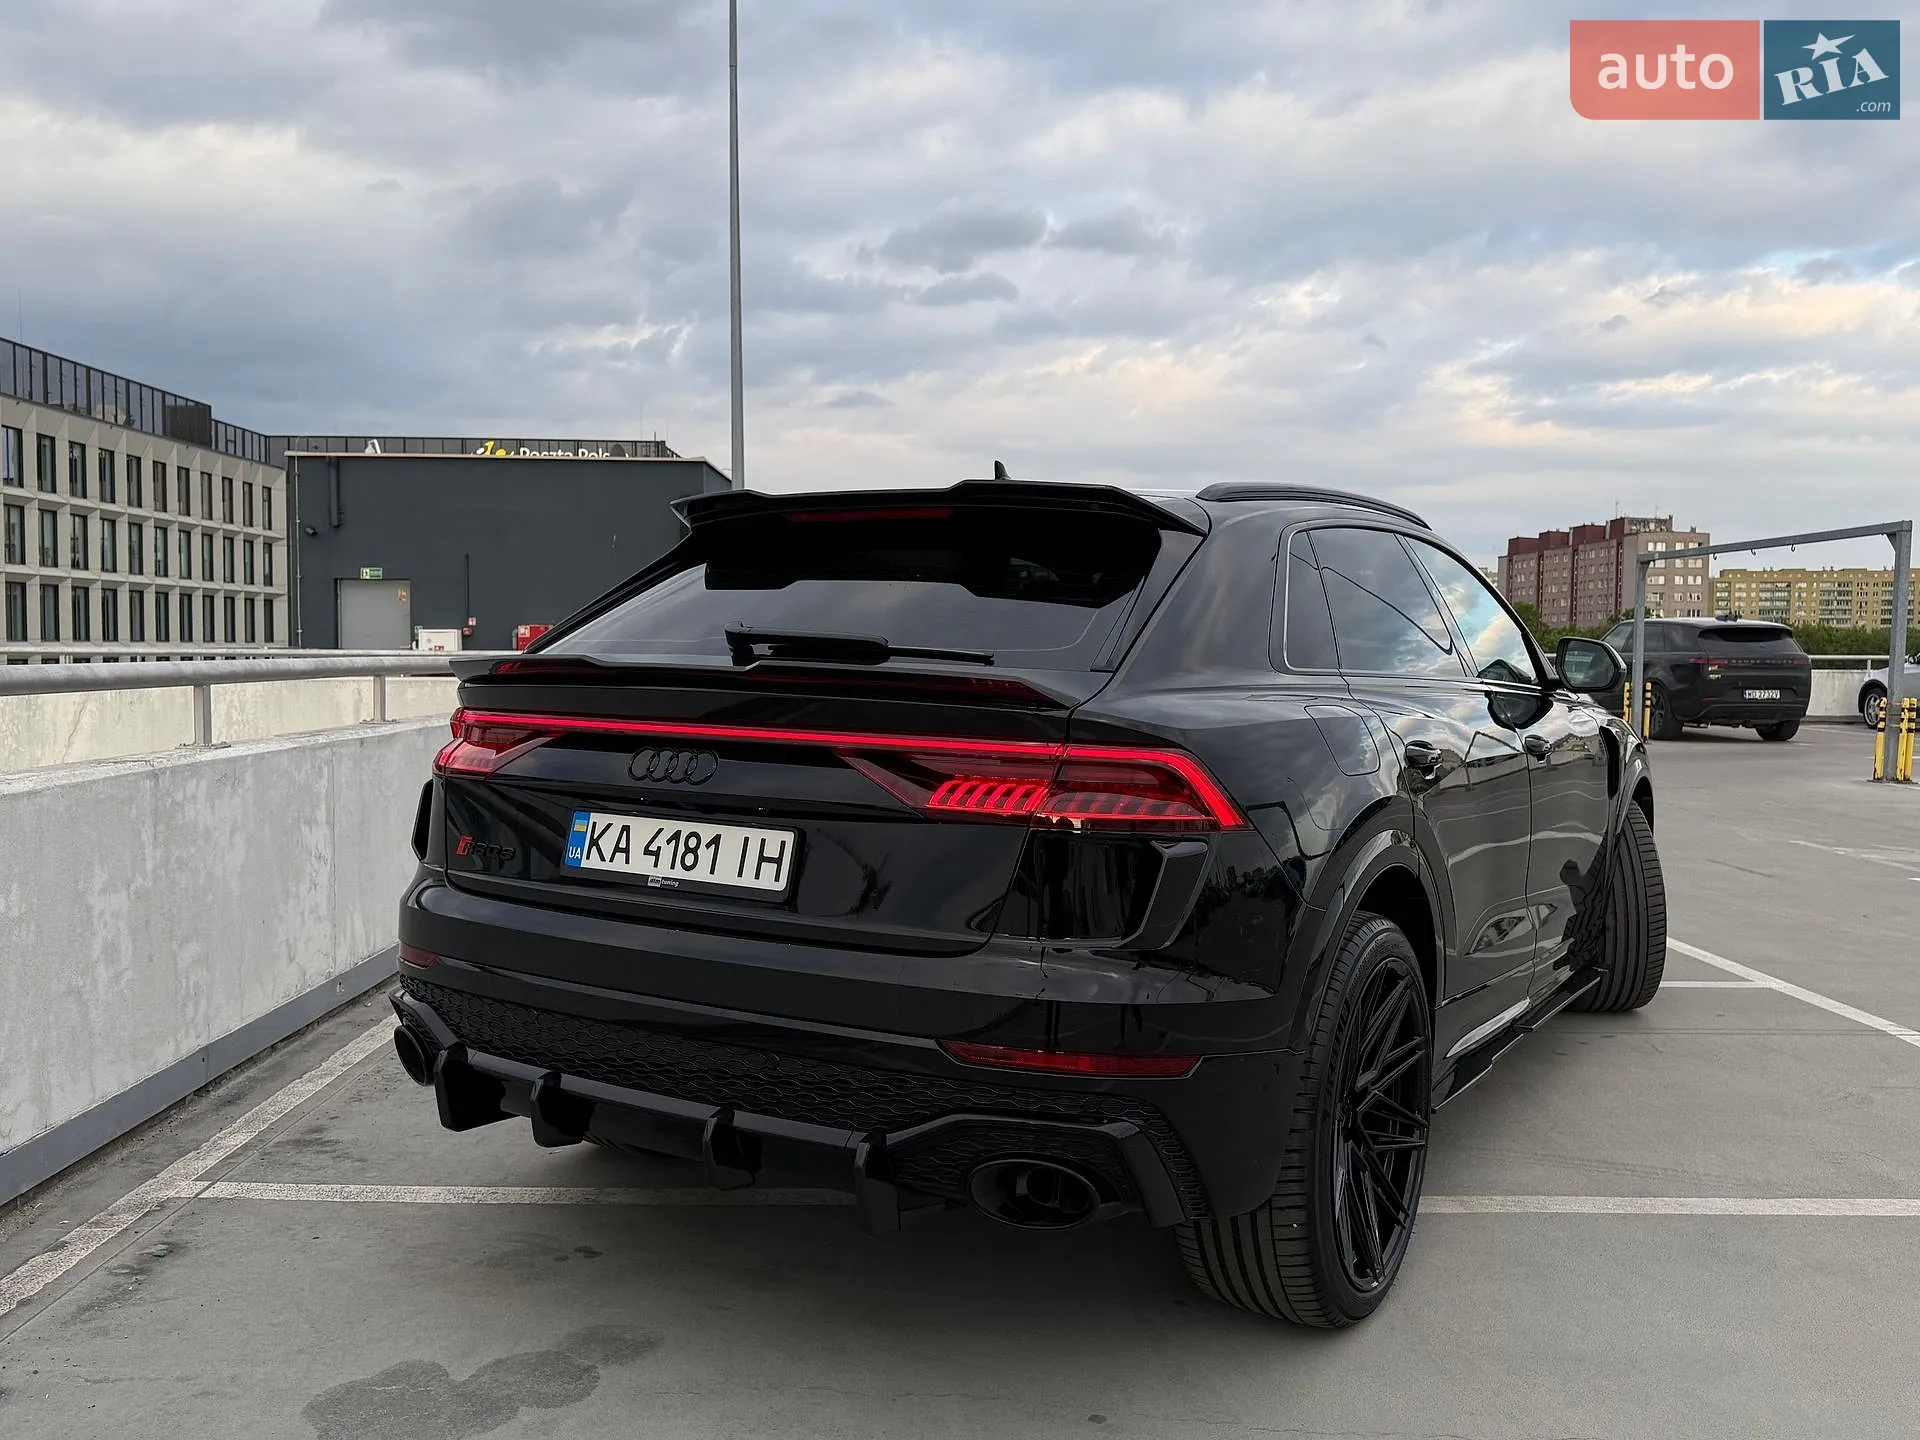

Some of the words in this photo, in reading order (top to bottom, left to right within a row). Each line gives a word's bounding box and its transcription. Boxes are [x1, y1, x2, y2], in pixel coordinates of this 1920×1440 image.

[568, 846, 582, 859] UA
[585, 821, 631, 865] KA
[642, 827, 722, 875] 4181
[736, 835, 787, 883] IH
